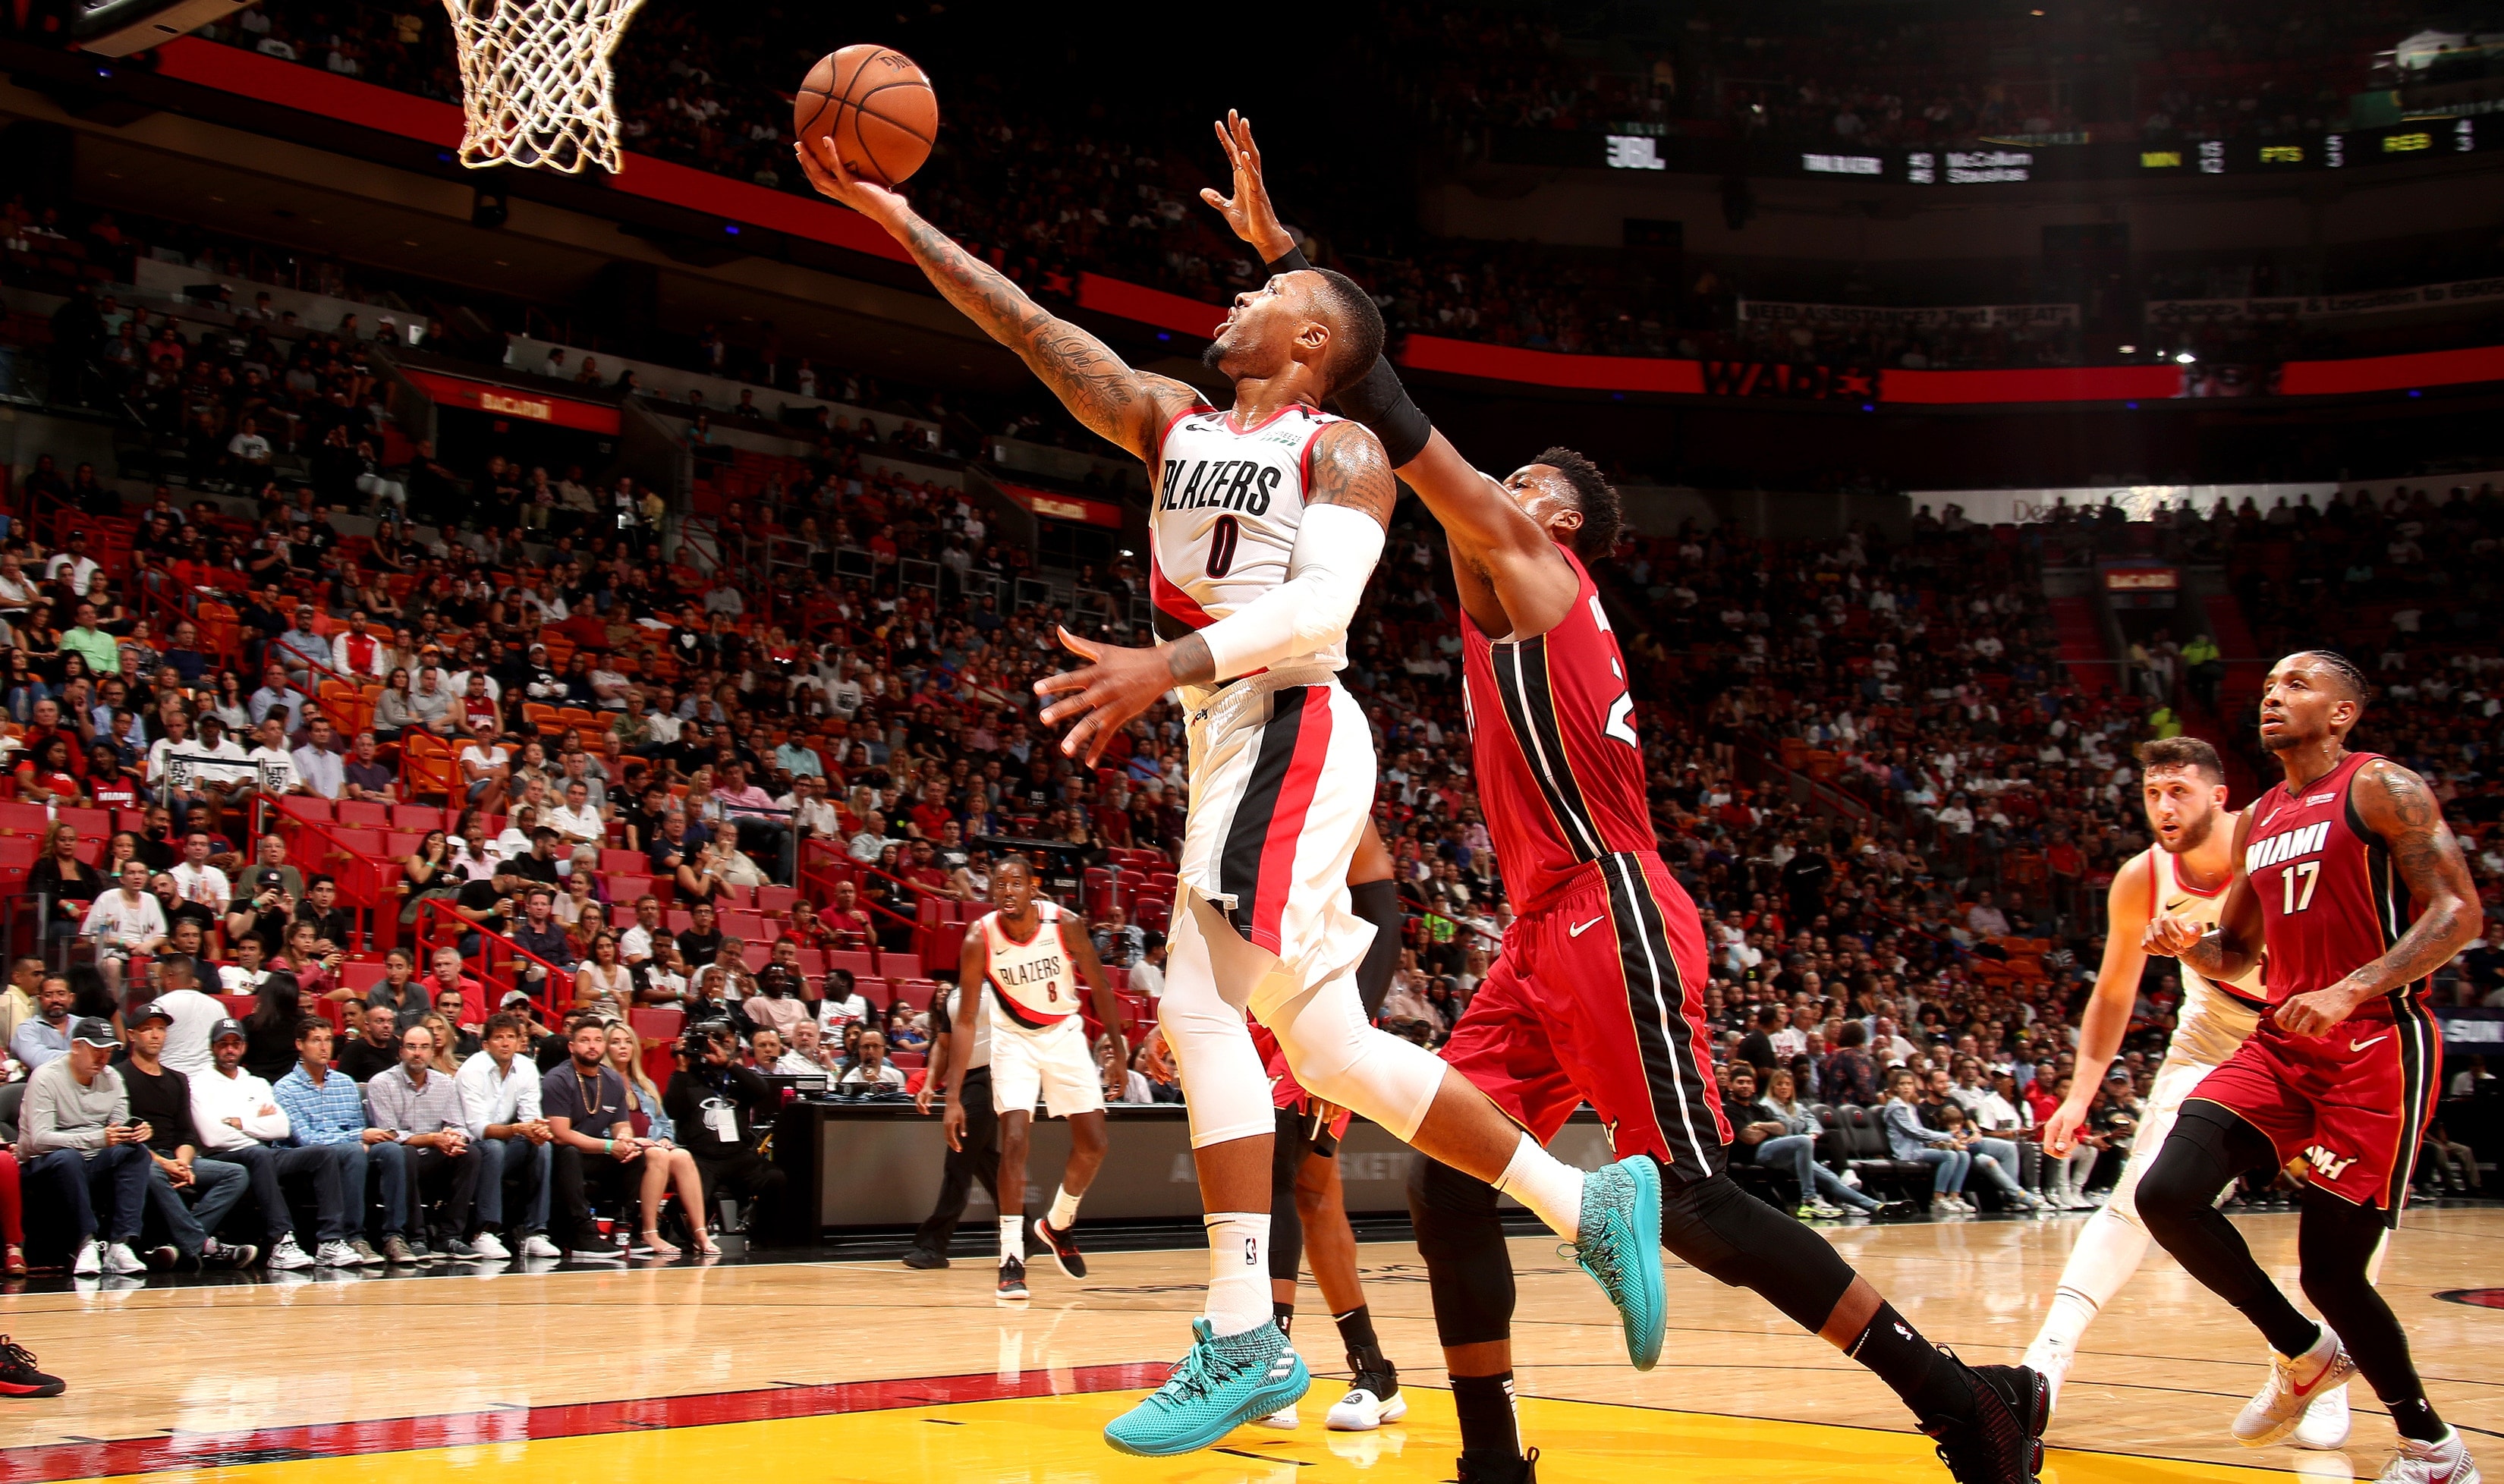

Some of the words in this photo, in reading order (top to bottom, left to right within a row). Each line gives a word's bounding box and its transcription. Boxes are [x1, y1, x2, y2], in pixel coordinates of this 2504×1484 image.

[2260, 146, 2304, 163] PTS
[2383, 132, 2432, 152] REB
[1159, 459, 1282, 517] BLAZERS
[1206, 514, 1238, 579] 0
[2244, 820, 2333, 876] MIAMI
[2281, 860, 2321, 916] 17
[998, 956, 1060, 986] BLAZERS
[1046, 981, 1057, 1002] 8
